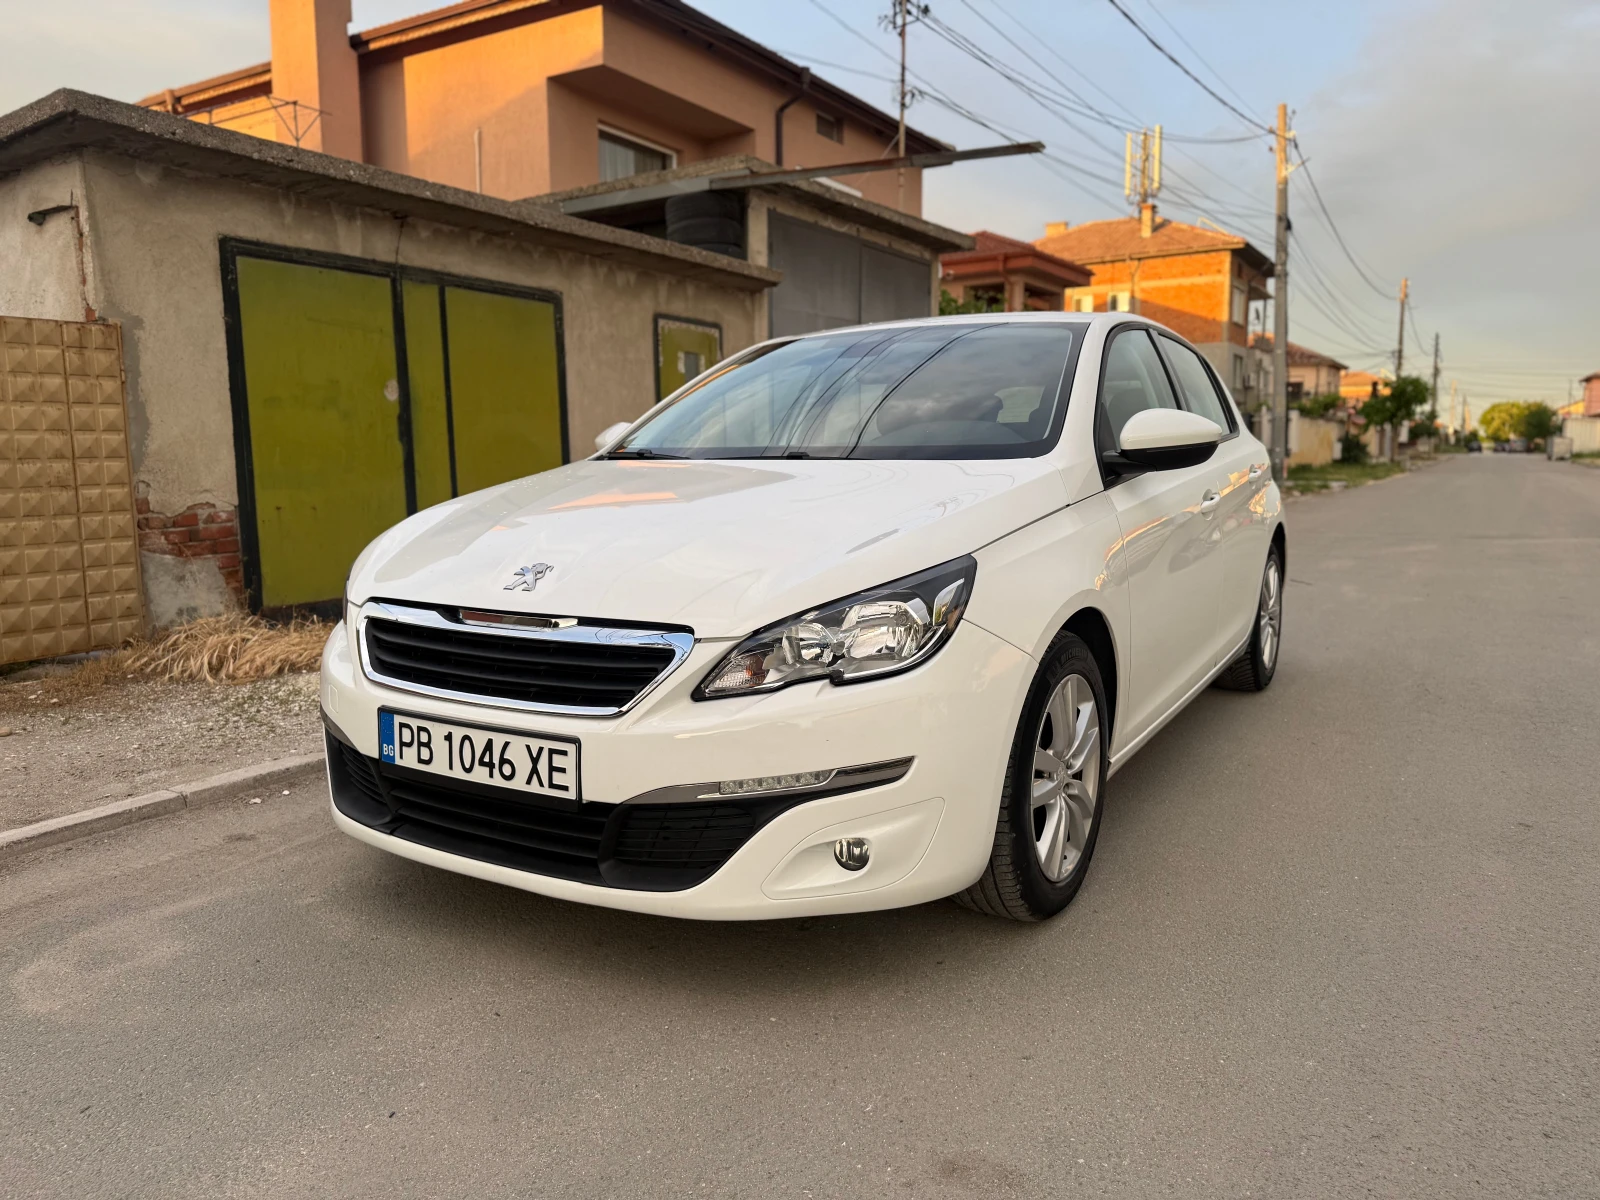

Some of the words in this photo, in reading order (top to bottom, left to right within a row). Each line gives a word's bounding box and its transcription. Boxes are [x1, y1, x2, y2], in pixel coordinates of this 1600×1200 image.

[383, 743, 394, 756] BG
[399, 722, 433, 765] PB
[444, 731, 516, 781] 1046
[525, 744, 569, 792] XE
